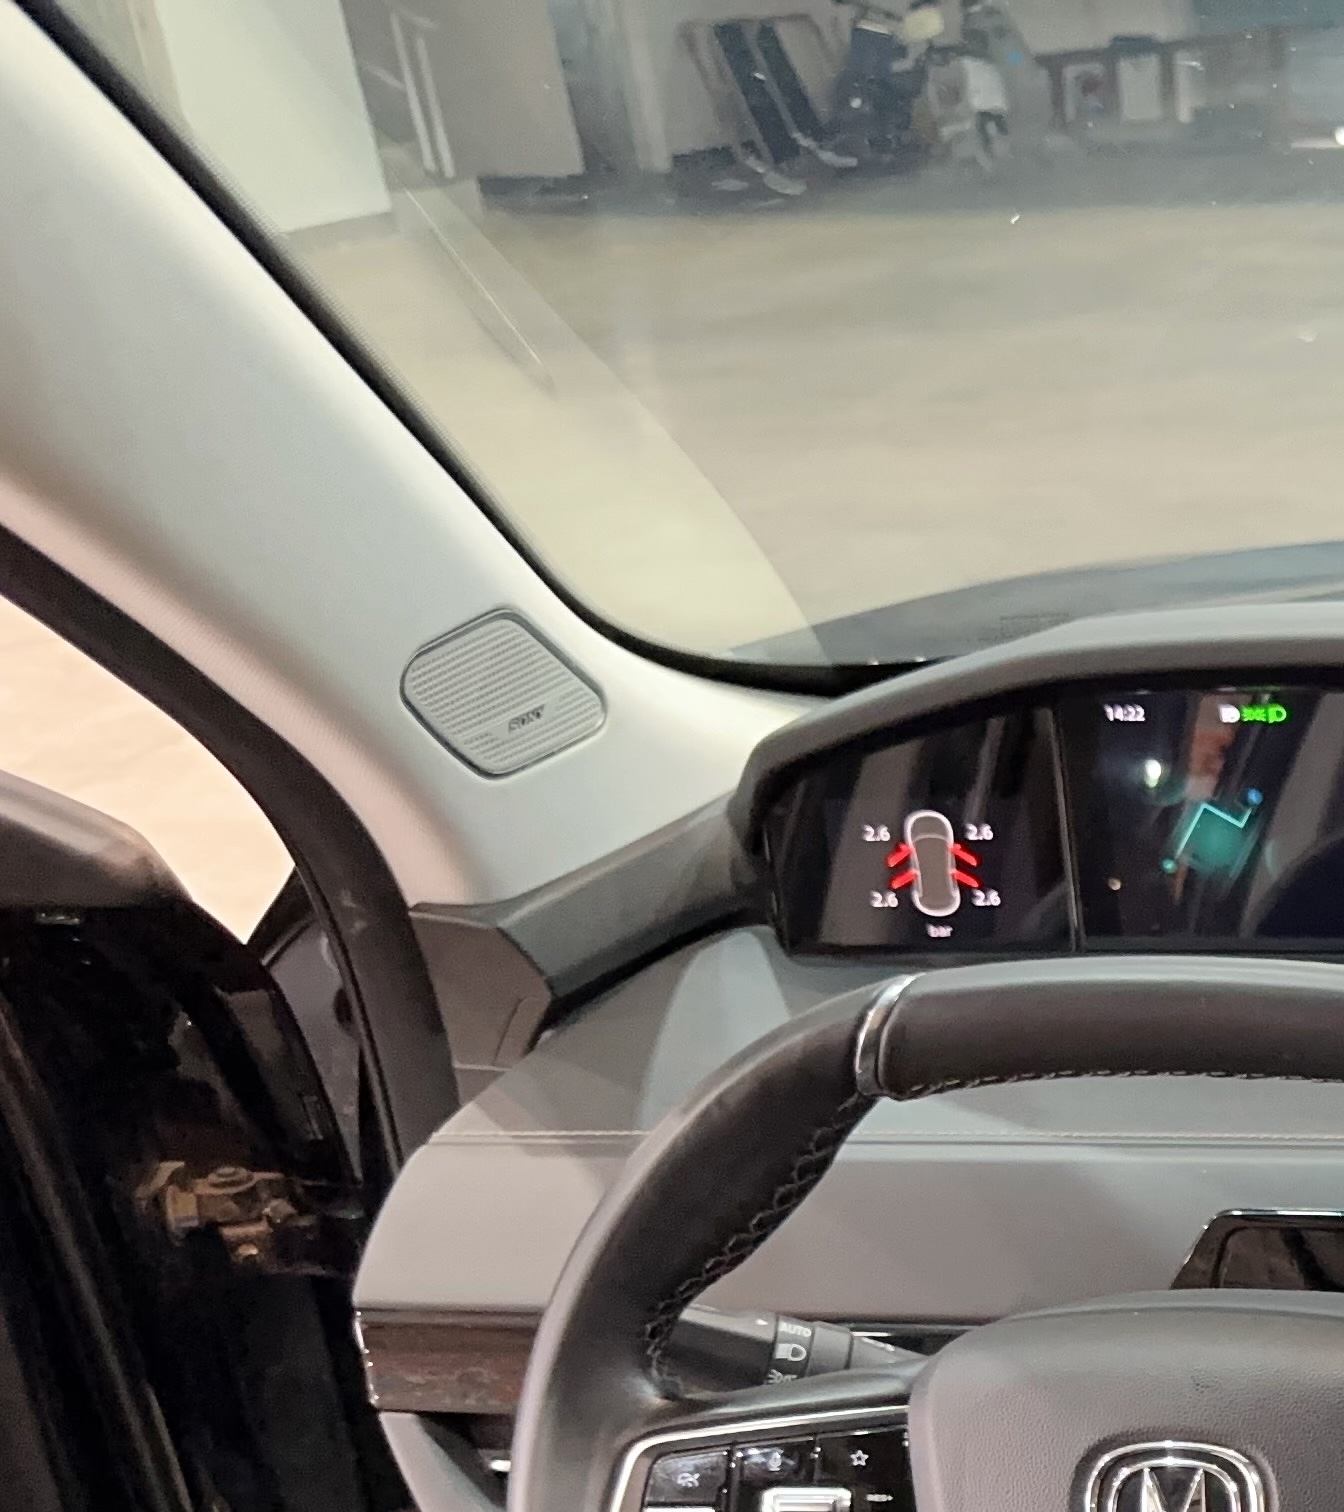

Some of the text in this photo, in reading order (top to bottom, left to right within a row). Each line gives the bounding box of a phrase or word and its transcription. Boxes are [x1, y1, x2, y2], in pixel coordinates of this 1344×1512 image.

[1105, 705, 1145, 722] 14:22
[863, 824, 890, 842] 2.6
[965, 823, 993, 841] 2.6
[870, 889, 898, 907] 2.6
[972, 888, 1001, 906] 2.6
[779, 1321, 812, 1339] AUTO
